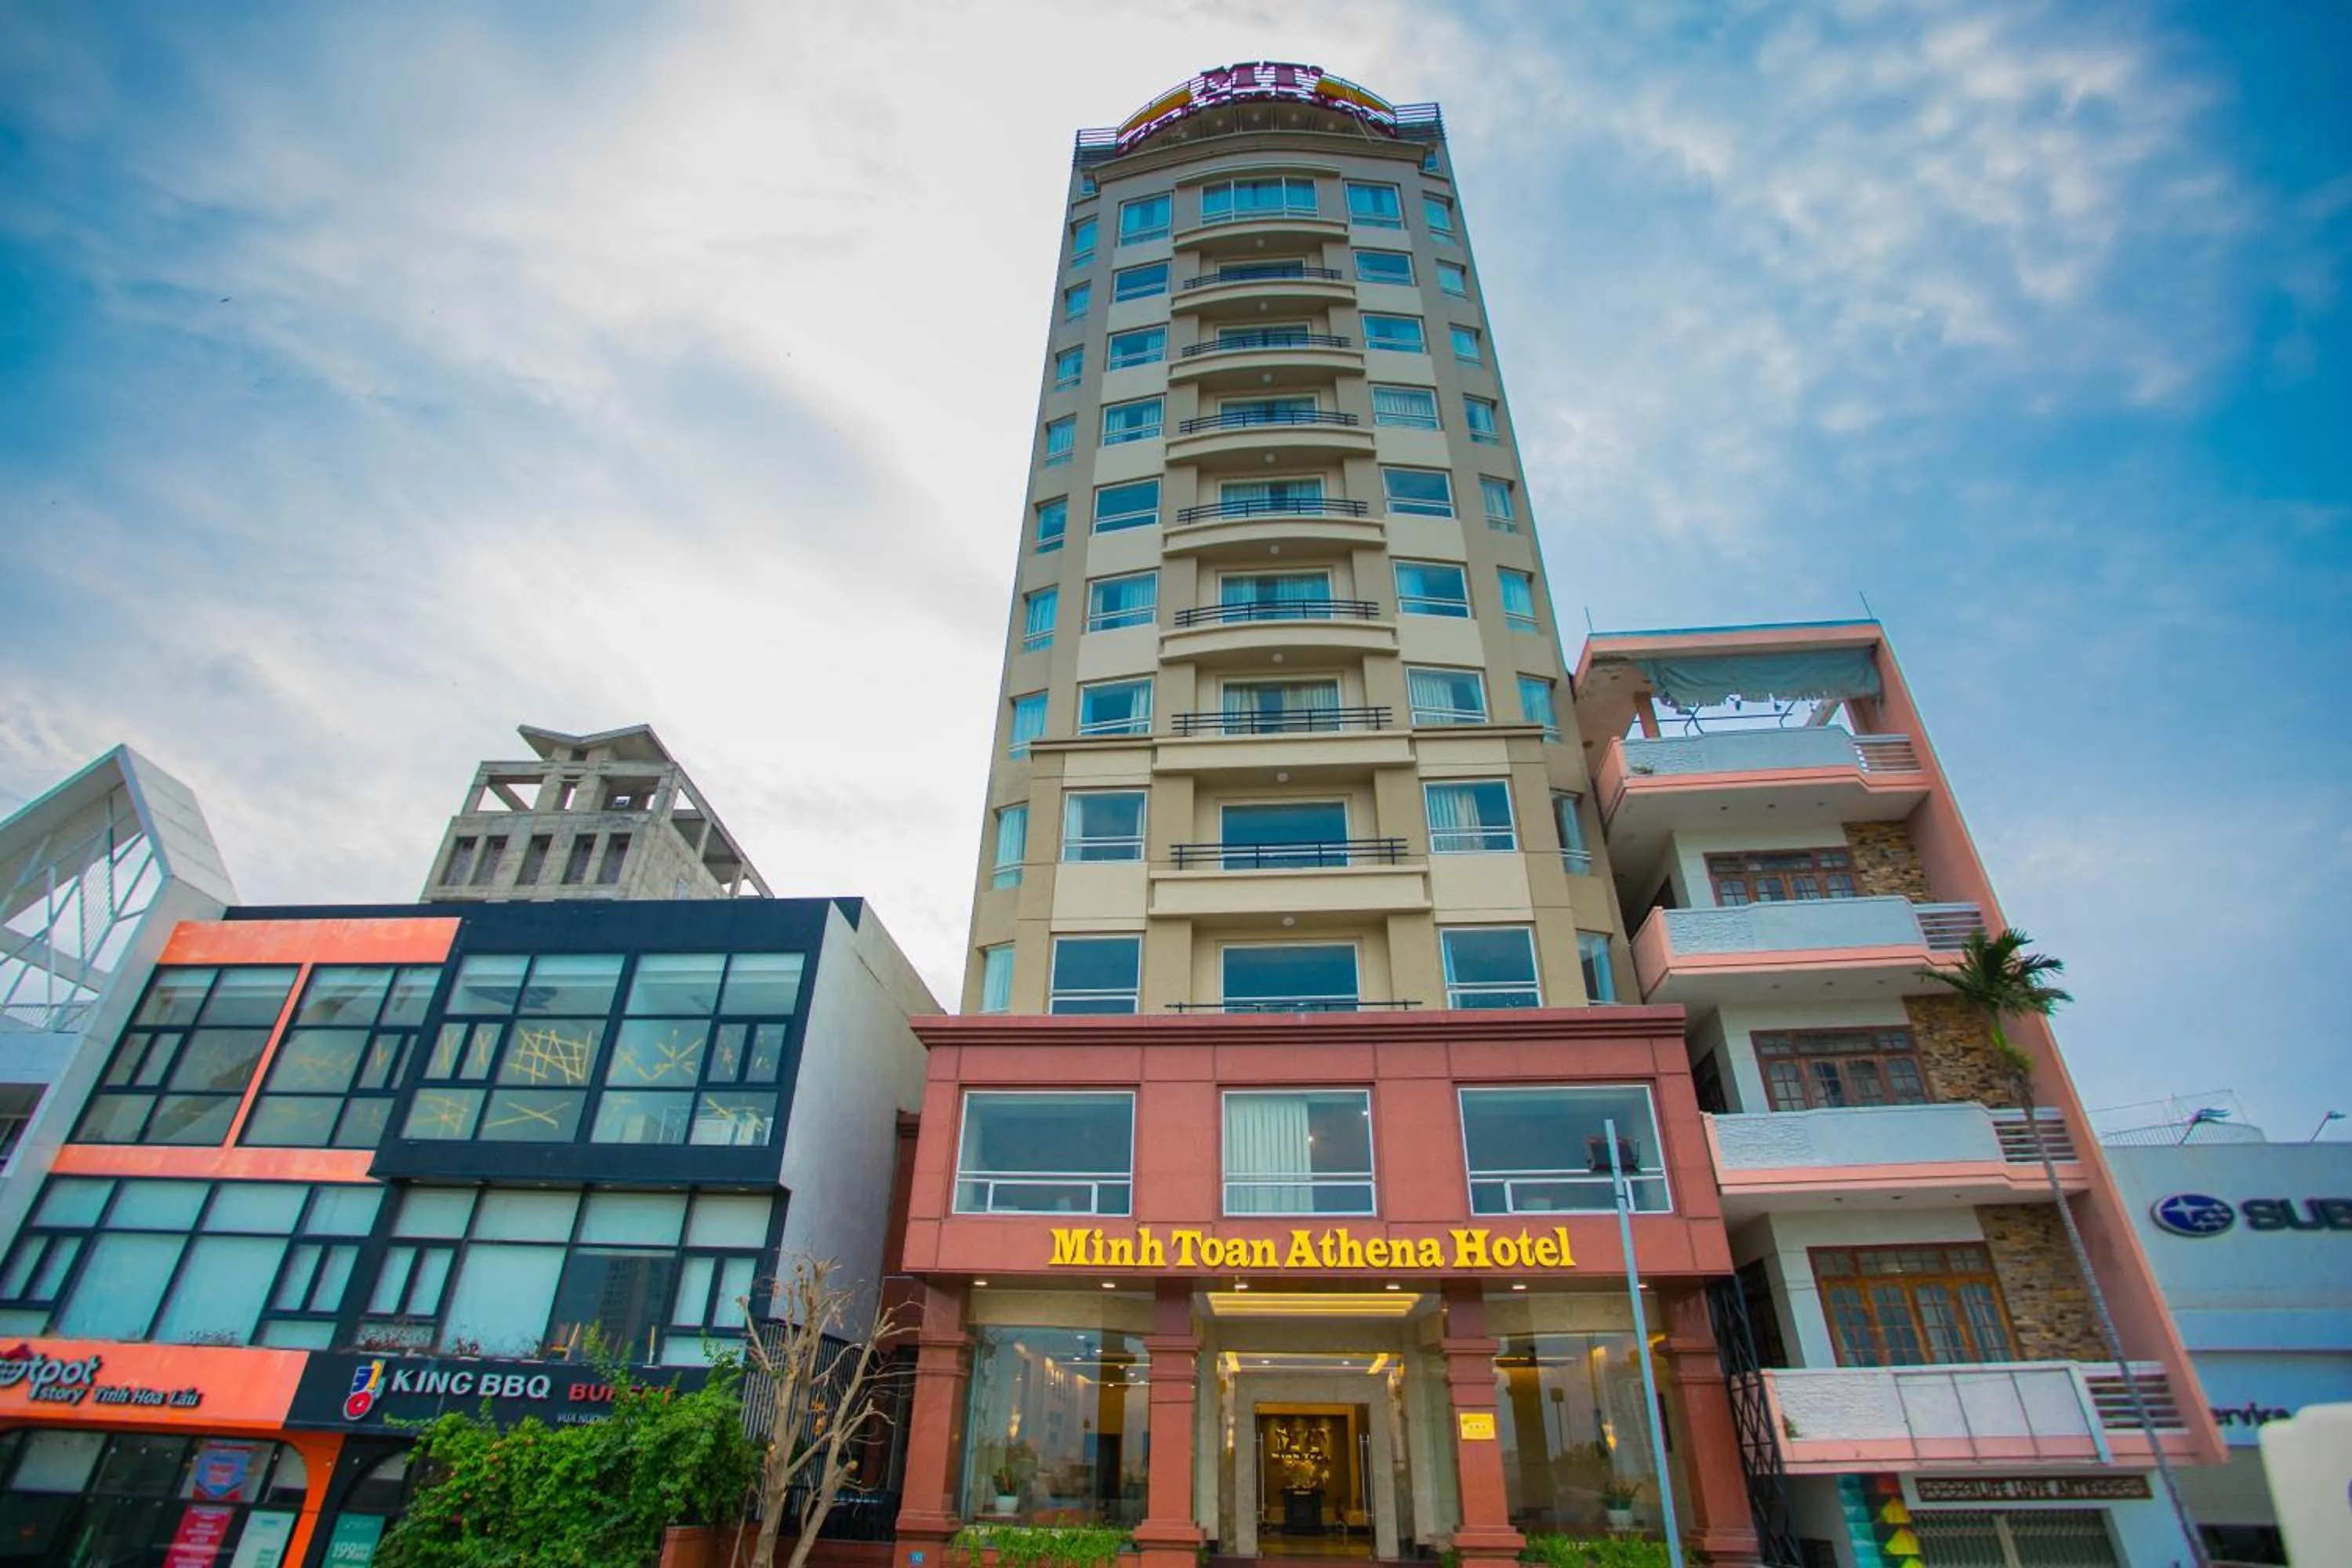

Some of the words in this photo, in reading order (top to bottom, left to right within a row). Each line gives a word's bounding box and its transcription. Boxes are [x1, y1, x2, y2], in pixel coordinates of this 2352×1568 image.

[1048, 1228, 1167, 1266] Minh
[1171, 1229, 1279, 1268] Toan
[1283, 1228, 1445, 1268] Athena
[1448, 1226, 1577, 1268] Hotel
[391, 1370, 474, 1396] KING
[477, 1374, 551, 1399] BBQ
